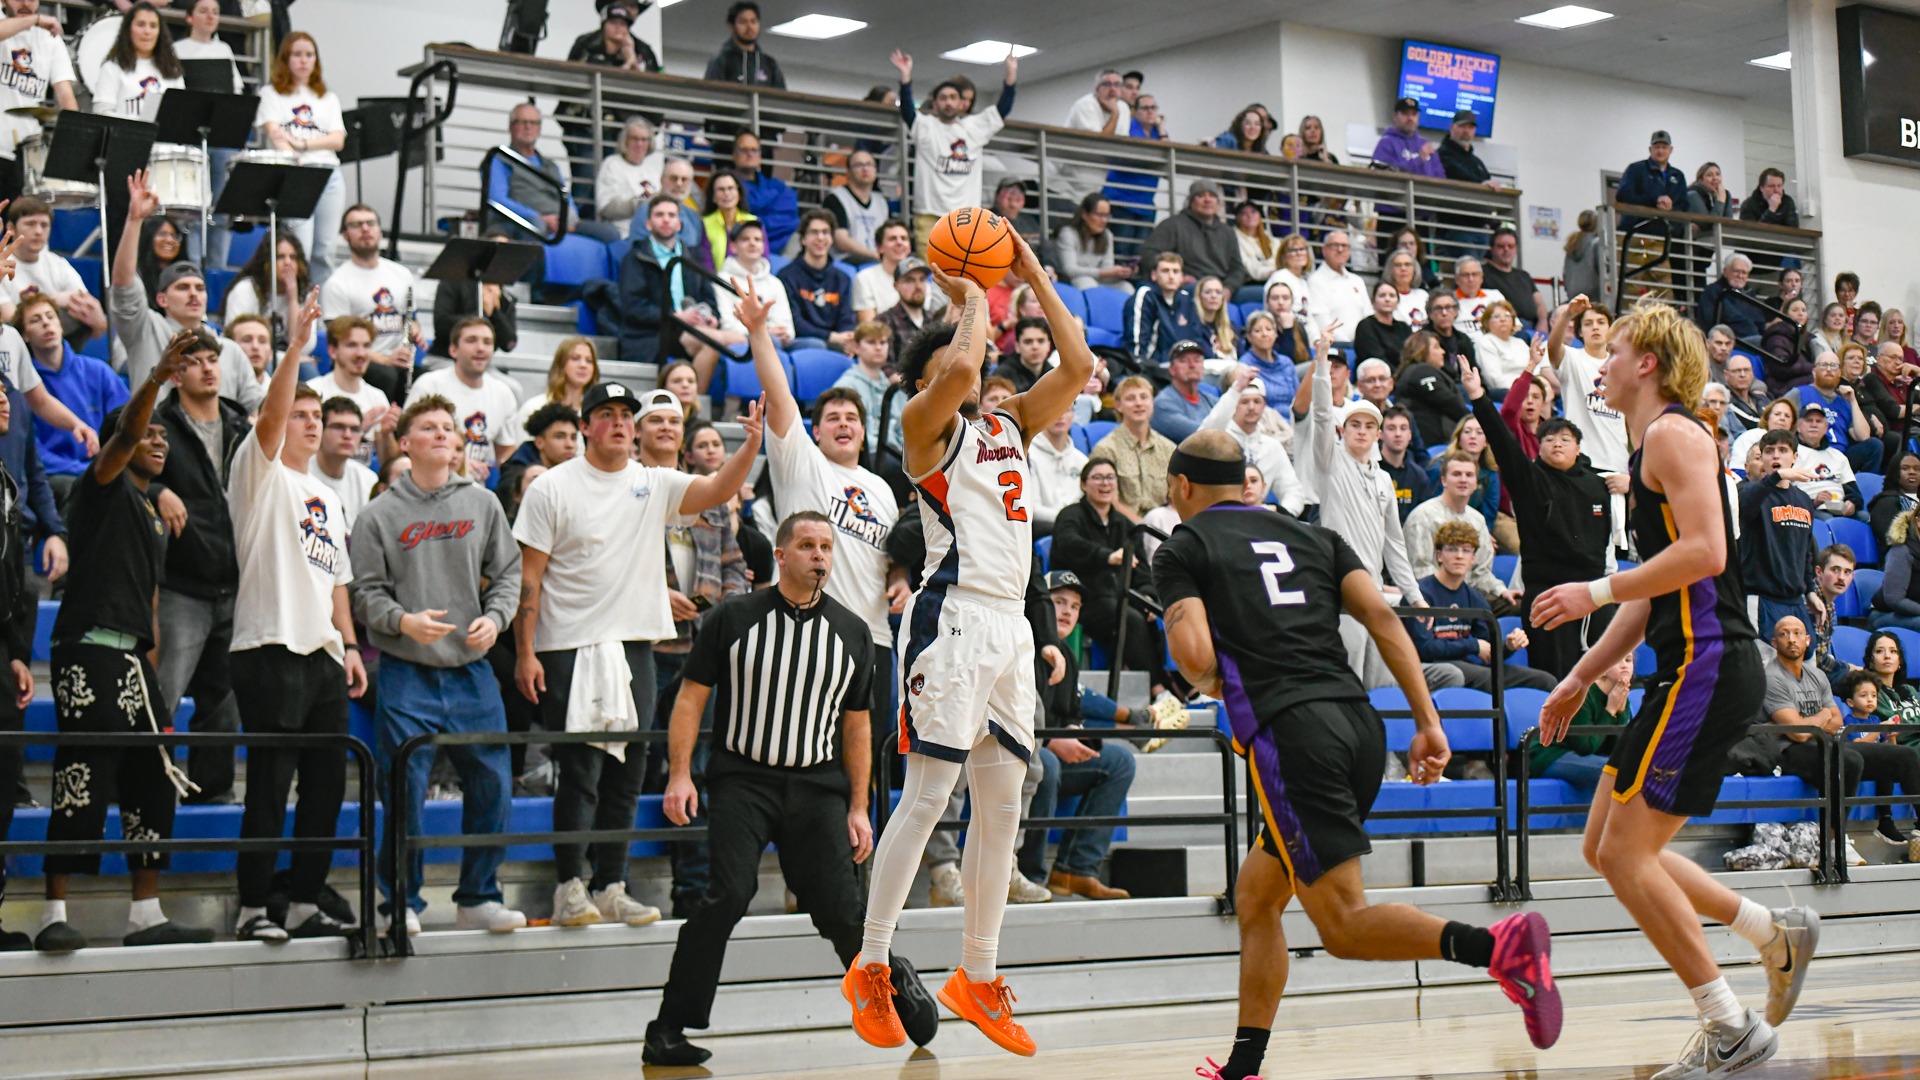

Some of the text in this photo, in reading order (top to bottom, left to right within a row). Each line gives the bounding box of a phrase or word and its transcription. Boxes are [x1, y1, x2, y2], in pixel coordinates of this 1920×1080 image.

[1407, 46, 1496, 73] GOLDEN TICKET
[1427, 63, 1473, 82] COMBOS
[1900, 117, 1920, 149] B
[998, 470, 1028, 522] 2
[398, 519, 474, 551] Glory
[1249, 540, 1307, 606] 2
